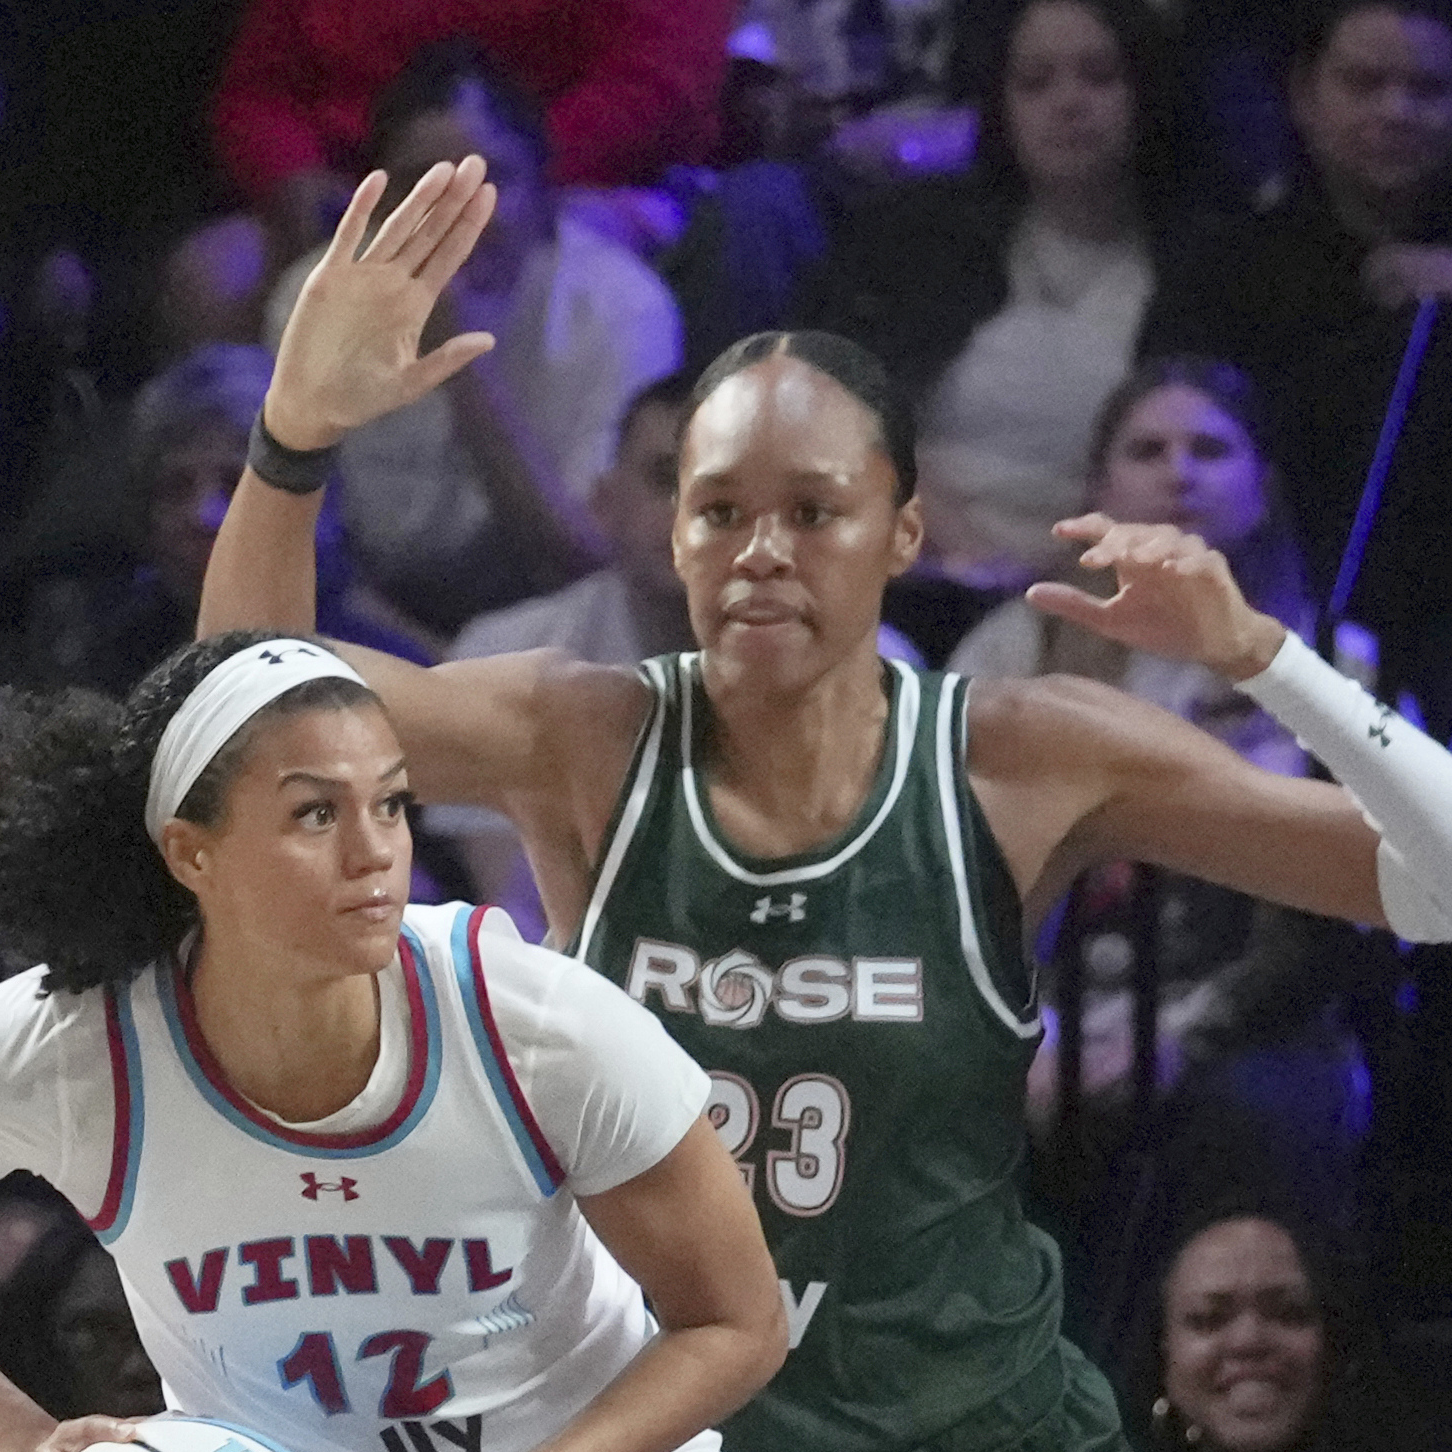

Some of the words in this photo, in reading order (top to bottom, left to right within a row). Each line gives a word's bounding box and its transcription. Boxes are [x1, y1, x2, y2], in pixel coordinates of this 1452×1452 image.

[625, 936, 924, 1029] ROSE
[164, 1233, 514, 1315] VINYL
[277, 1329, 456, 1420] 12
